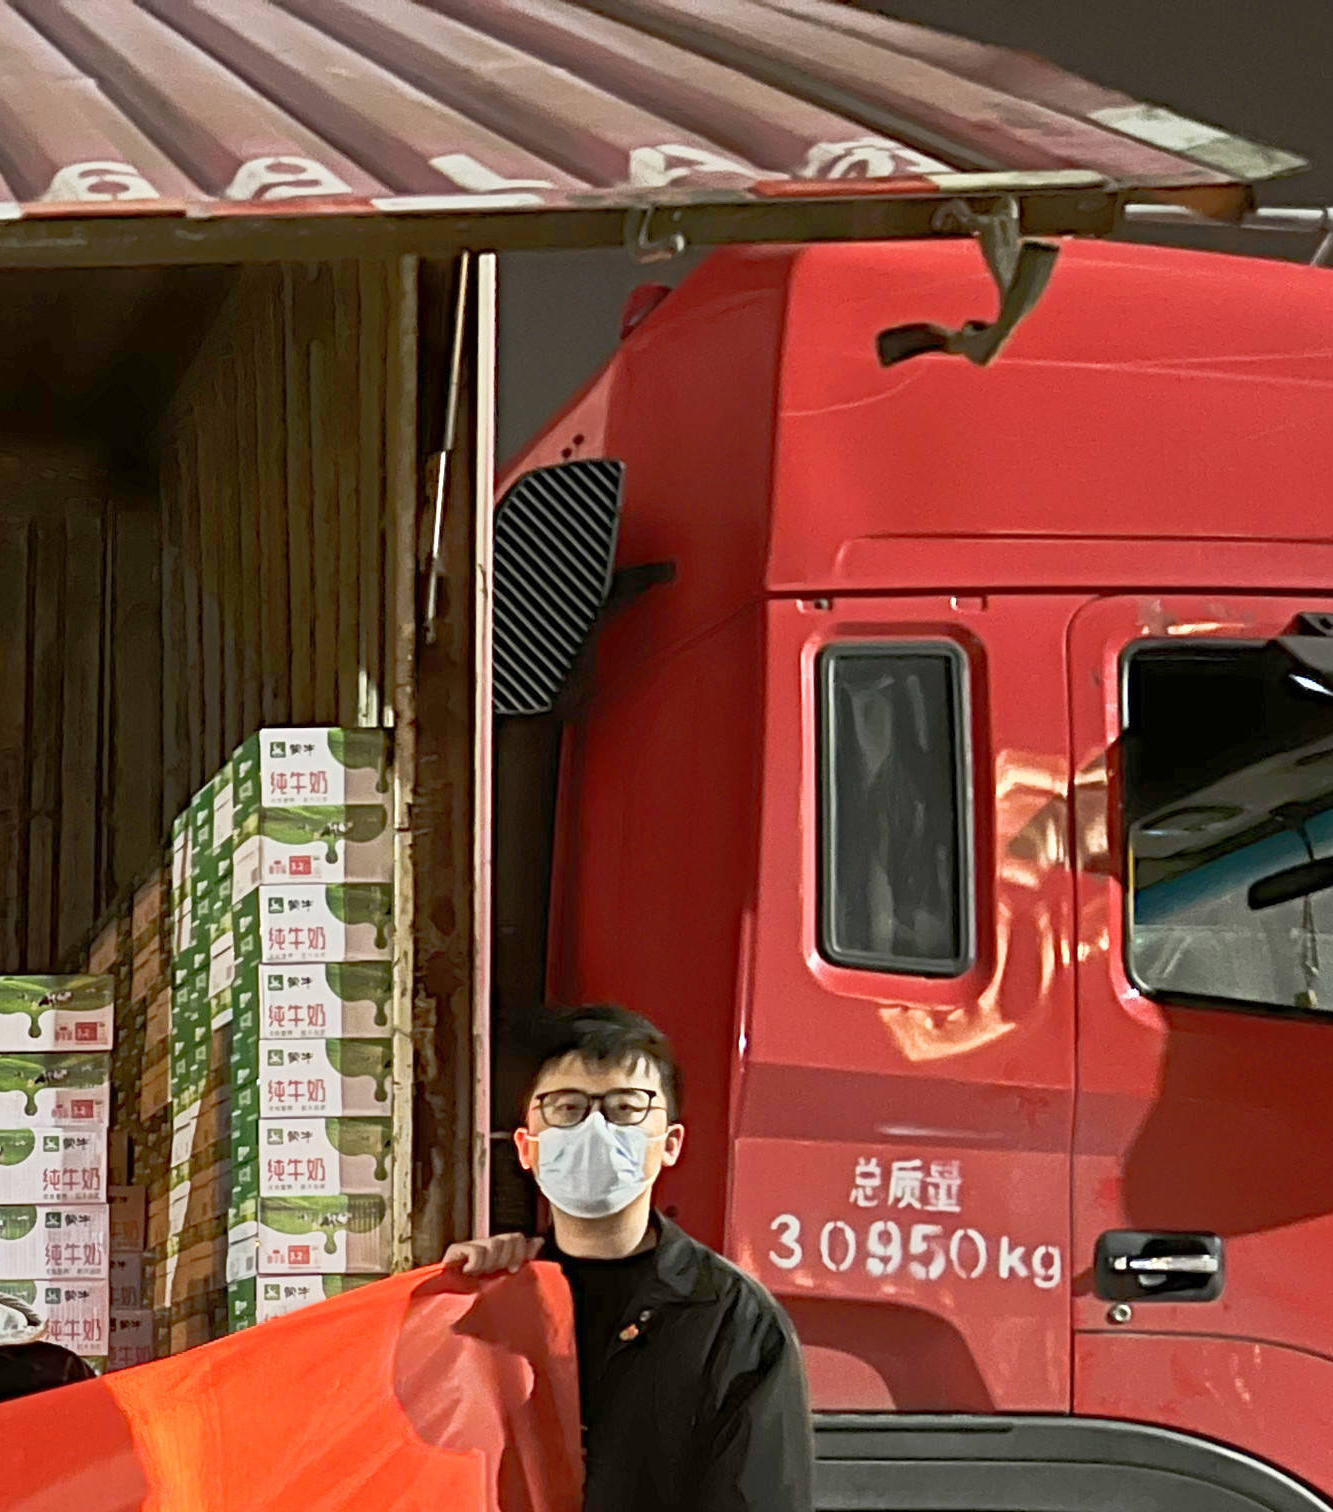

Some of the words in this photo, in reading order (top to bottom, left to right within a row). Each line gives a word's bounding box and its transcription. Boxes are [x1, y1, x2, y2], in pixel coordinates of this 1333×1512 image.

[270, 771, 328, 793] 纯牛奶
[268, 927, 326, 950] 纯牛奶
[268, 1005, 326, 1027] 纯牛奶
[268, 1079, 326, 1102] 纯牛奶
[43, 1168, 101, 1191] 纯牛奶
[266, 1157, 326, 1182] 纯牛奶
[850, 1157, 962, 1214] 总质量
[44, 1243, 103, 1267] 纯牛奶
[769, 1213, 1063, 1289] 30950kg
[44, 1319, 102, 1342] 纯牛奶
